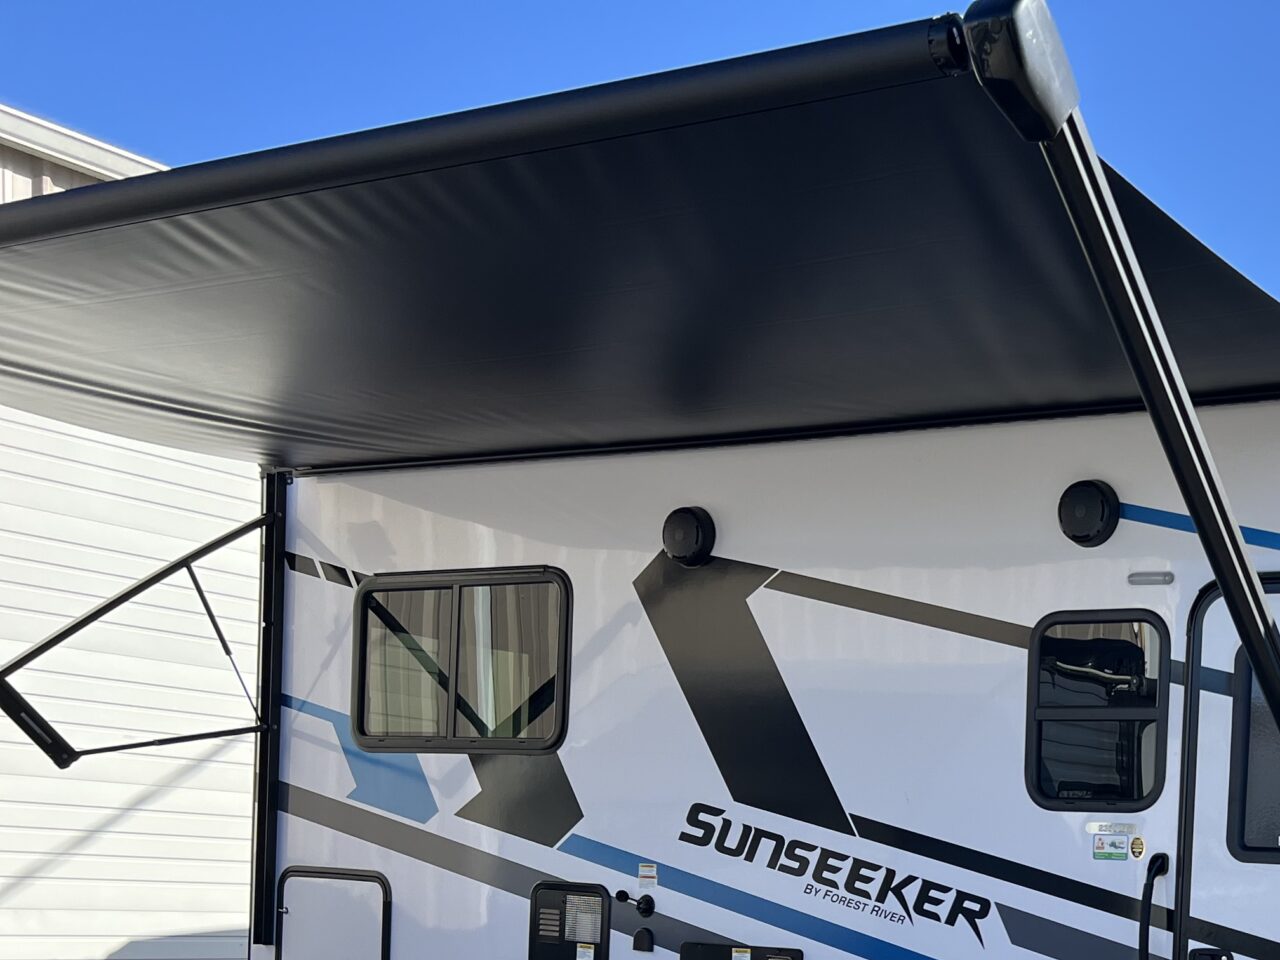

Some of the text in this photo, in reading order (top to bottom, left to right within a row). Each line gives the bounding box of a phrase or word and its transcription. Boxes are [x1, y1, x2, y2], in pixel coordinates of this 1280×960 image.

[803, 883, 907, 925] BY FOREST RIVER
